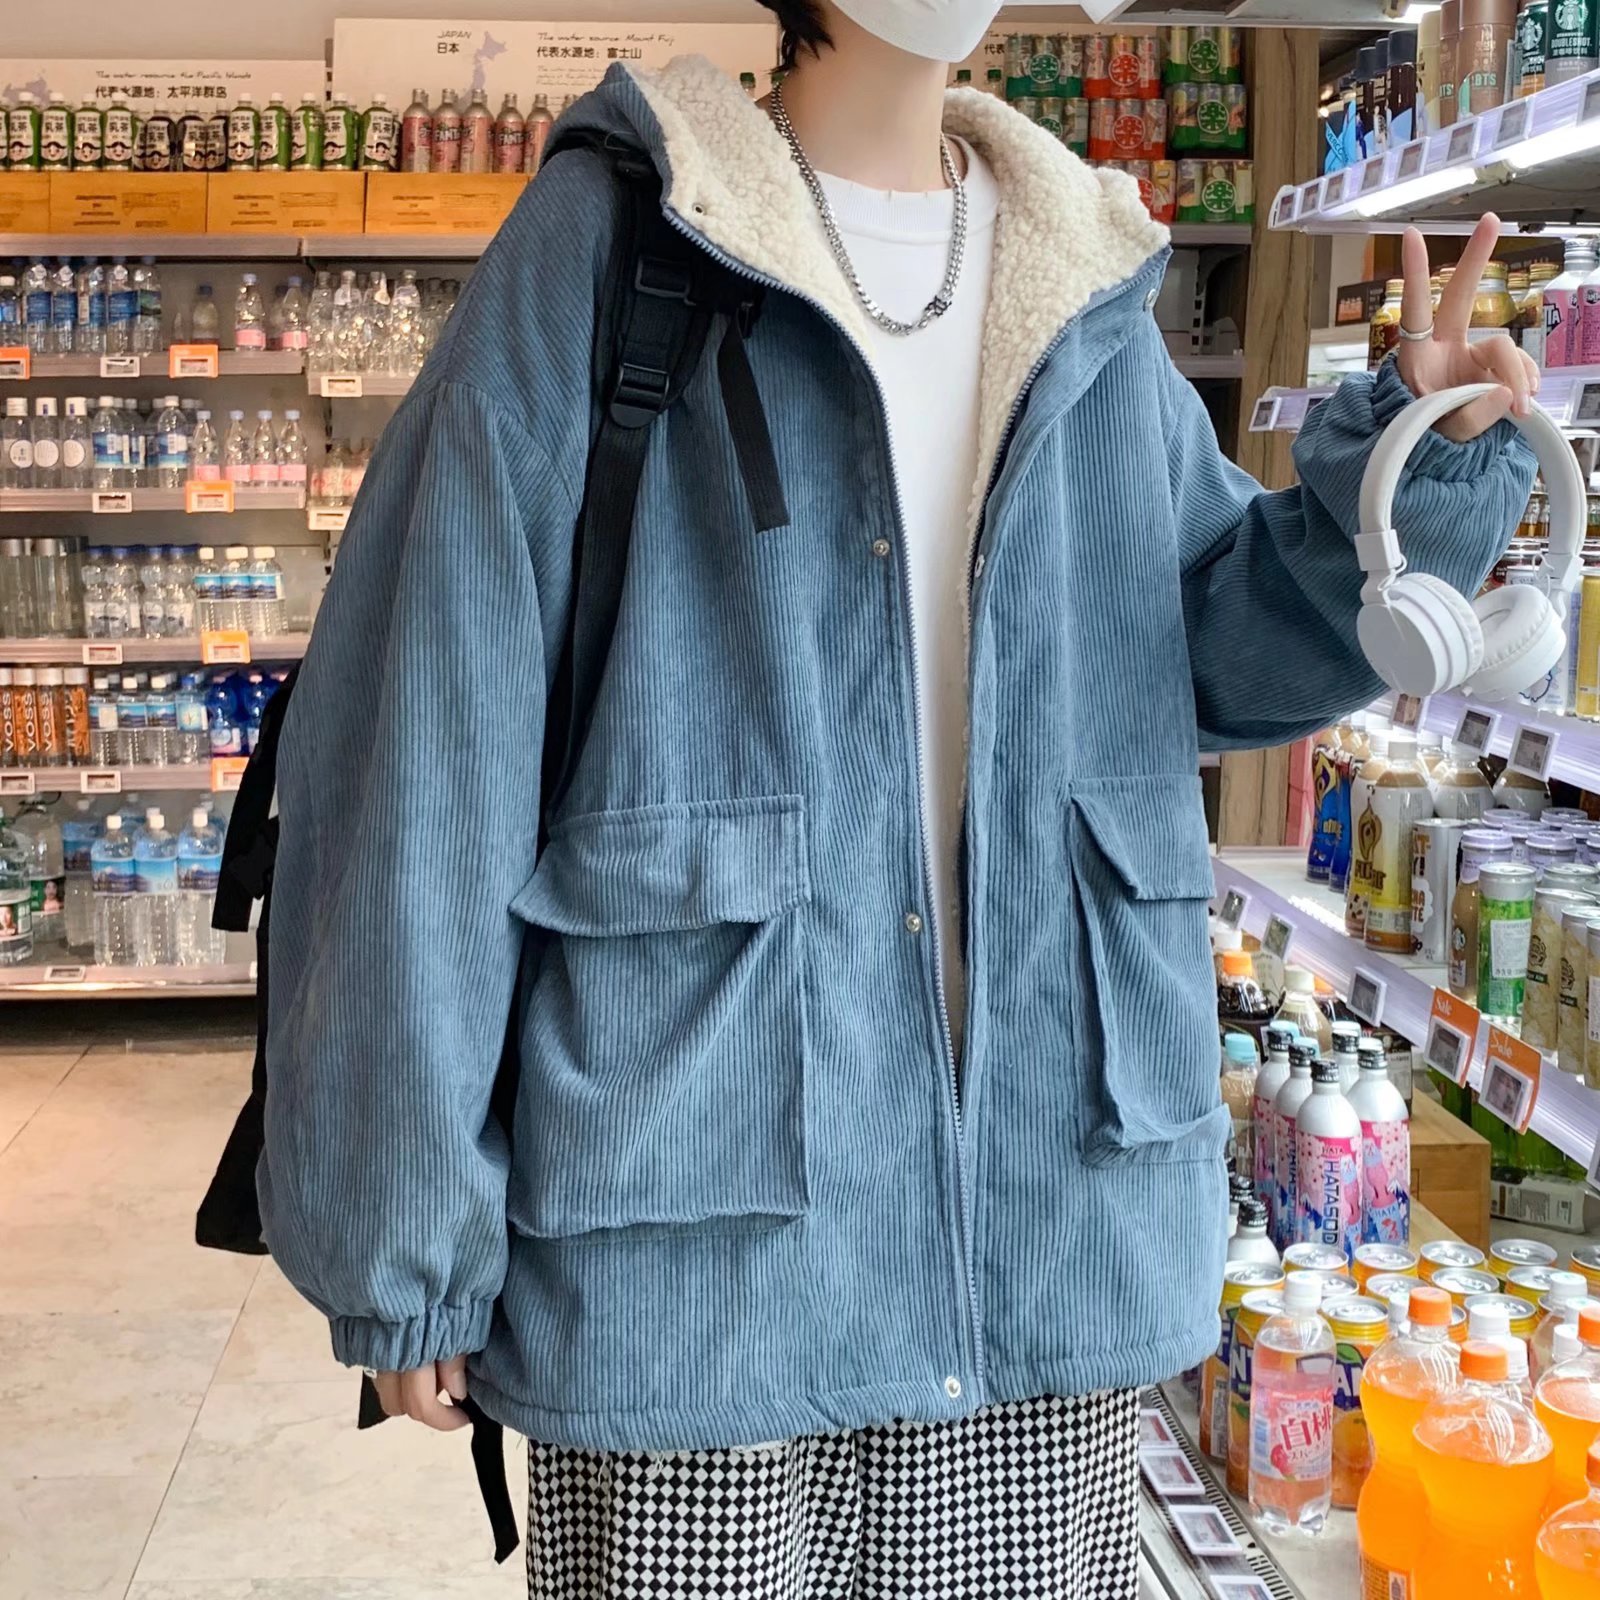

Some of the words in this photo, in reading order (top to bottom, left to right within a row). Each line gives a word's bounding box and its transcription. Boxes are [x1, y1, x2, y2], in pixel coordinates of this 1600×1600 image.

[438, 31, 471, 39] JAPAN
[438, 42, 459, 53] 日本
[3, 692, 14, 752] VOSS
[25, 692, 36, 752] VOSS
[41, 692, 52, 752] VOSS
[1436, 996, 1452, 1016] Sale
[1490, 1029, 1512, 1059] Sale
[1322, 1146, 1344, 1154] HATA
[1281, 1405, 1332, 1451] 白桃
